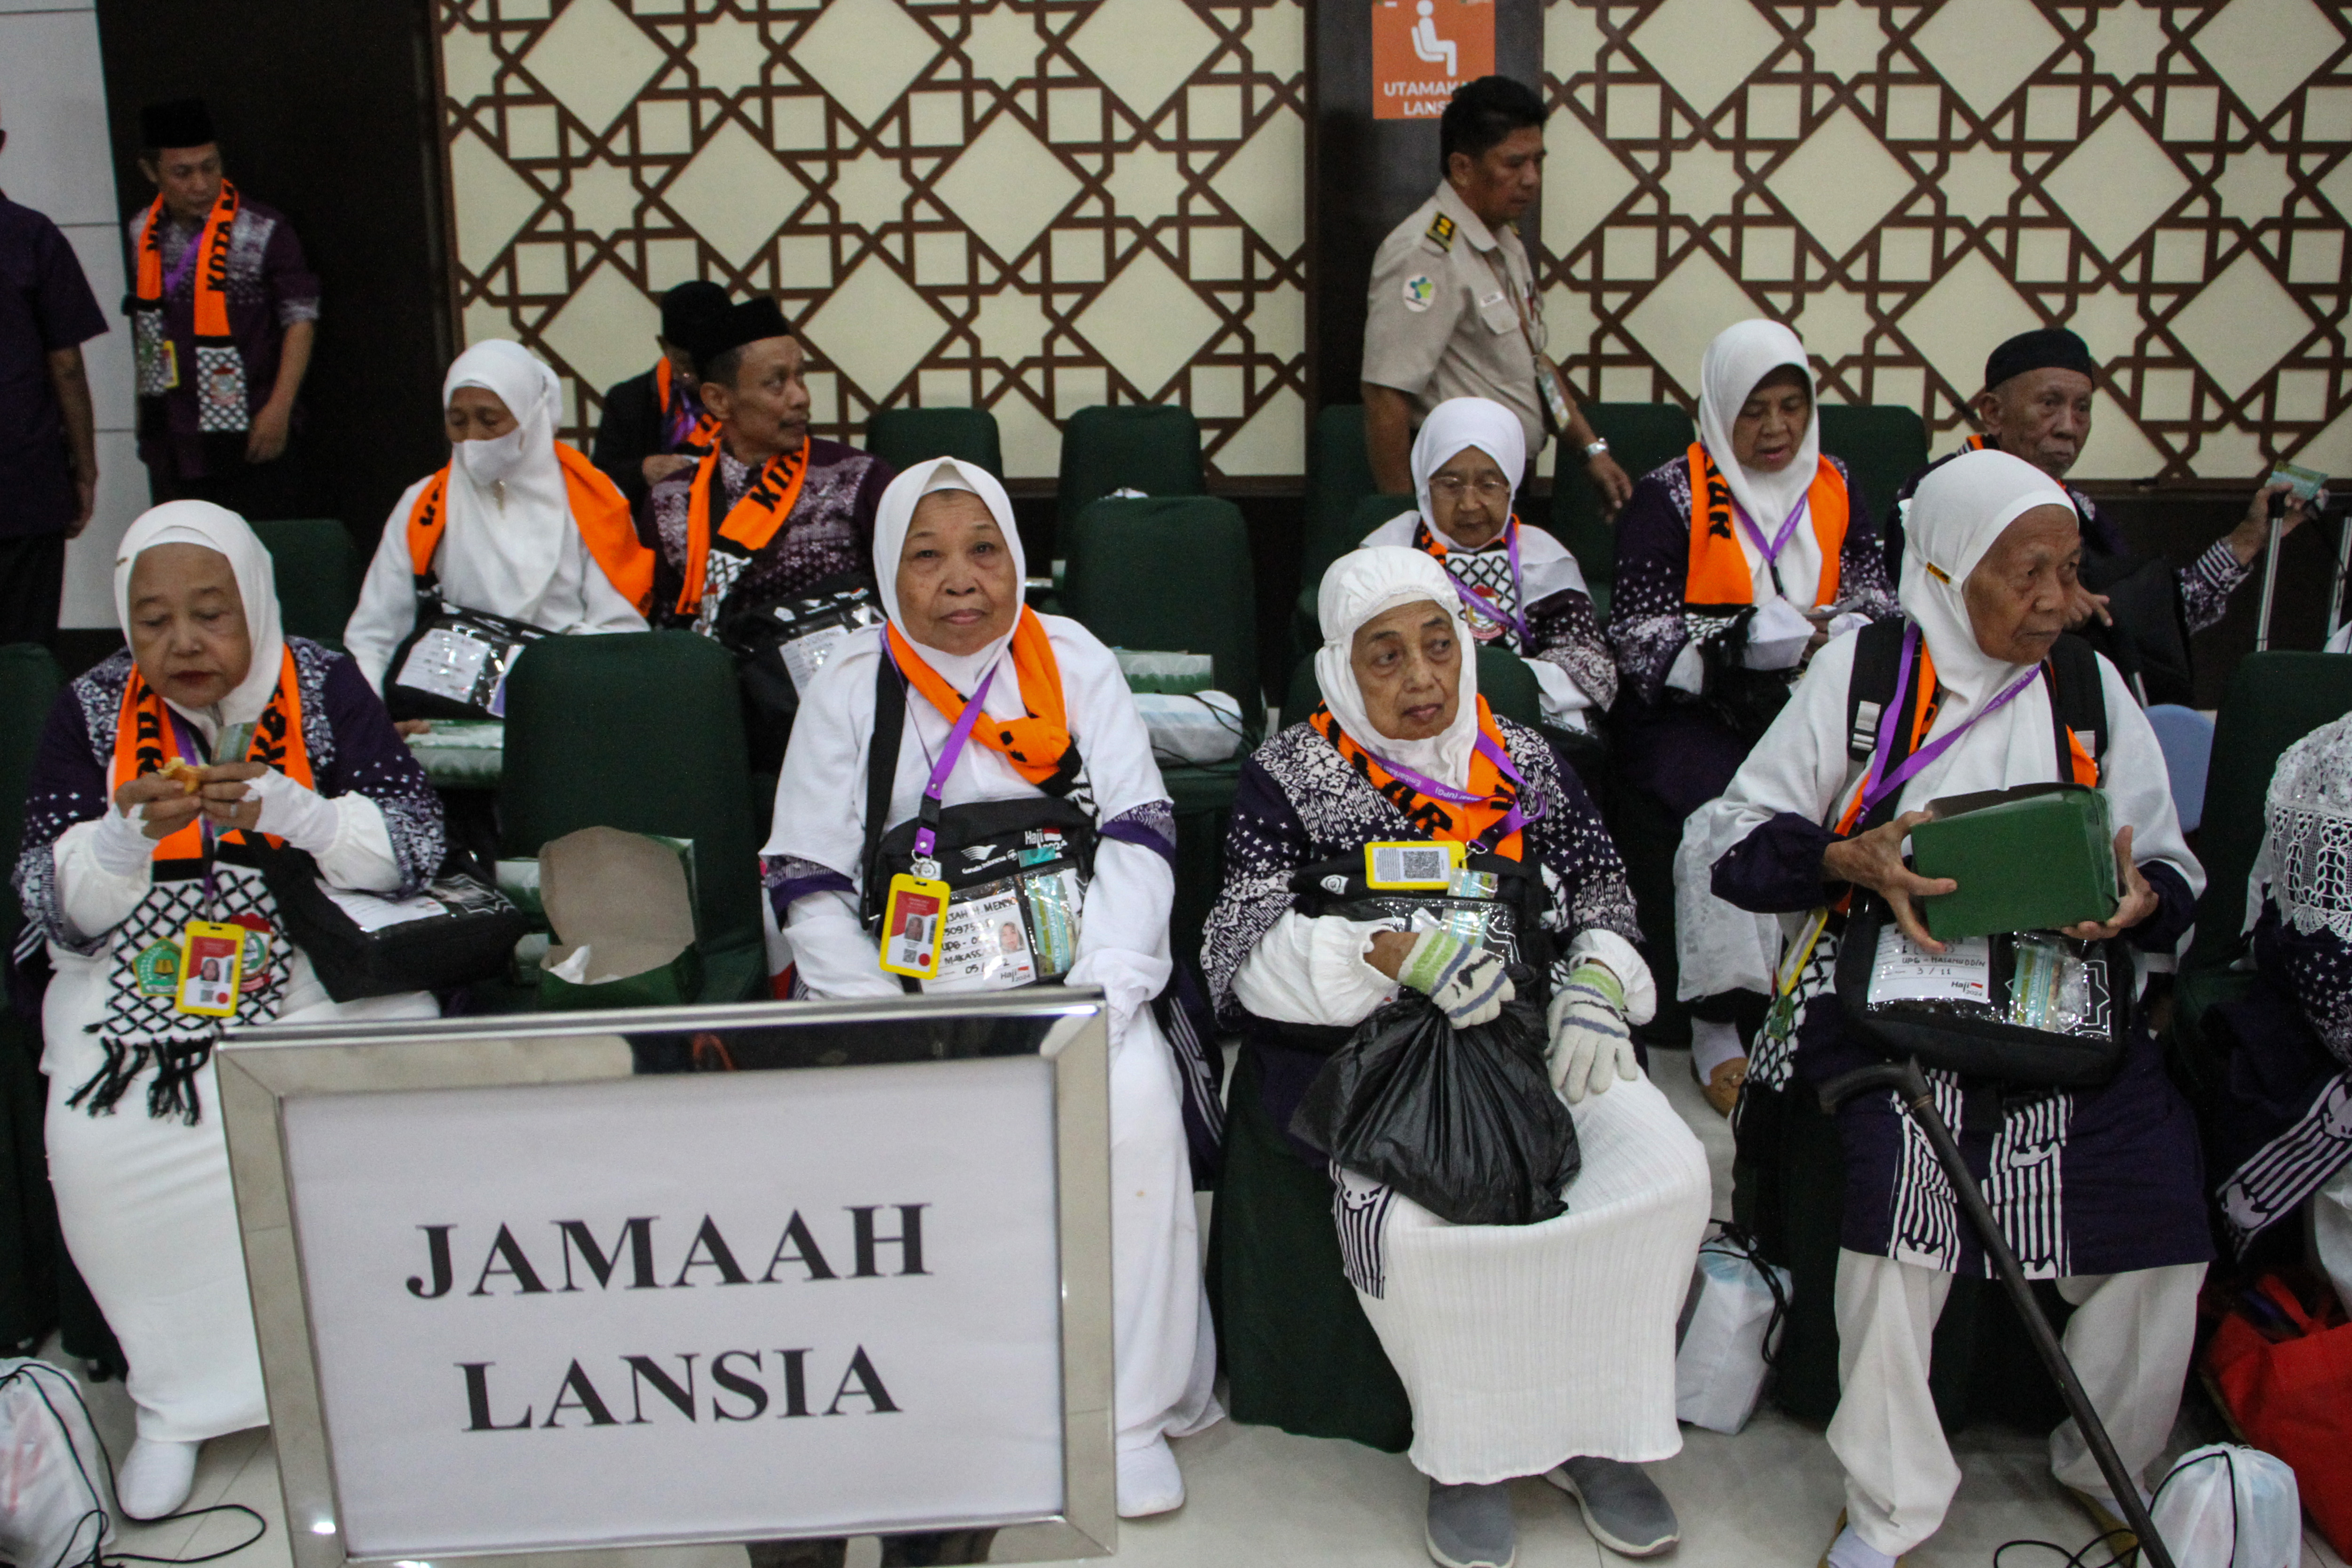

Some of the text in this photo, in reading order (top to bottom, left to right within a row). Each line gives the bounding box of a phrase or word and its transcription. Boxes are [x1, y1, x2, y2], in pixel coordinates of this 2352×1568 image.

[1383, 81, 1468, 97] UTAMAK
[1404, 100, 1448, 116] LANS
[1951, 981, 1970, 993] Haji
[405, 1202, 934, 1300] JAMAAH
[453, 1343, 905, 1433] LANSIA
